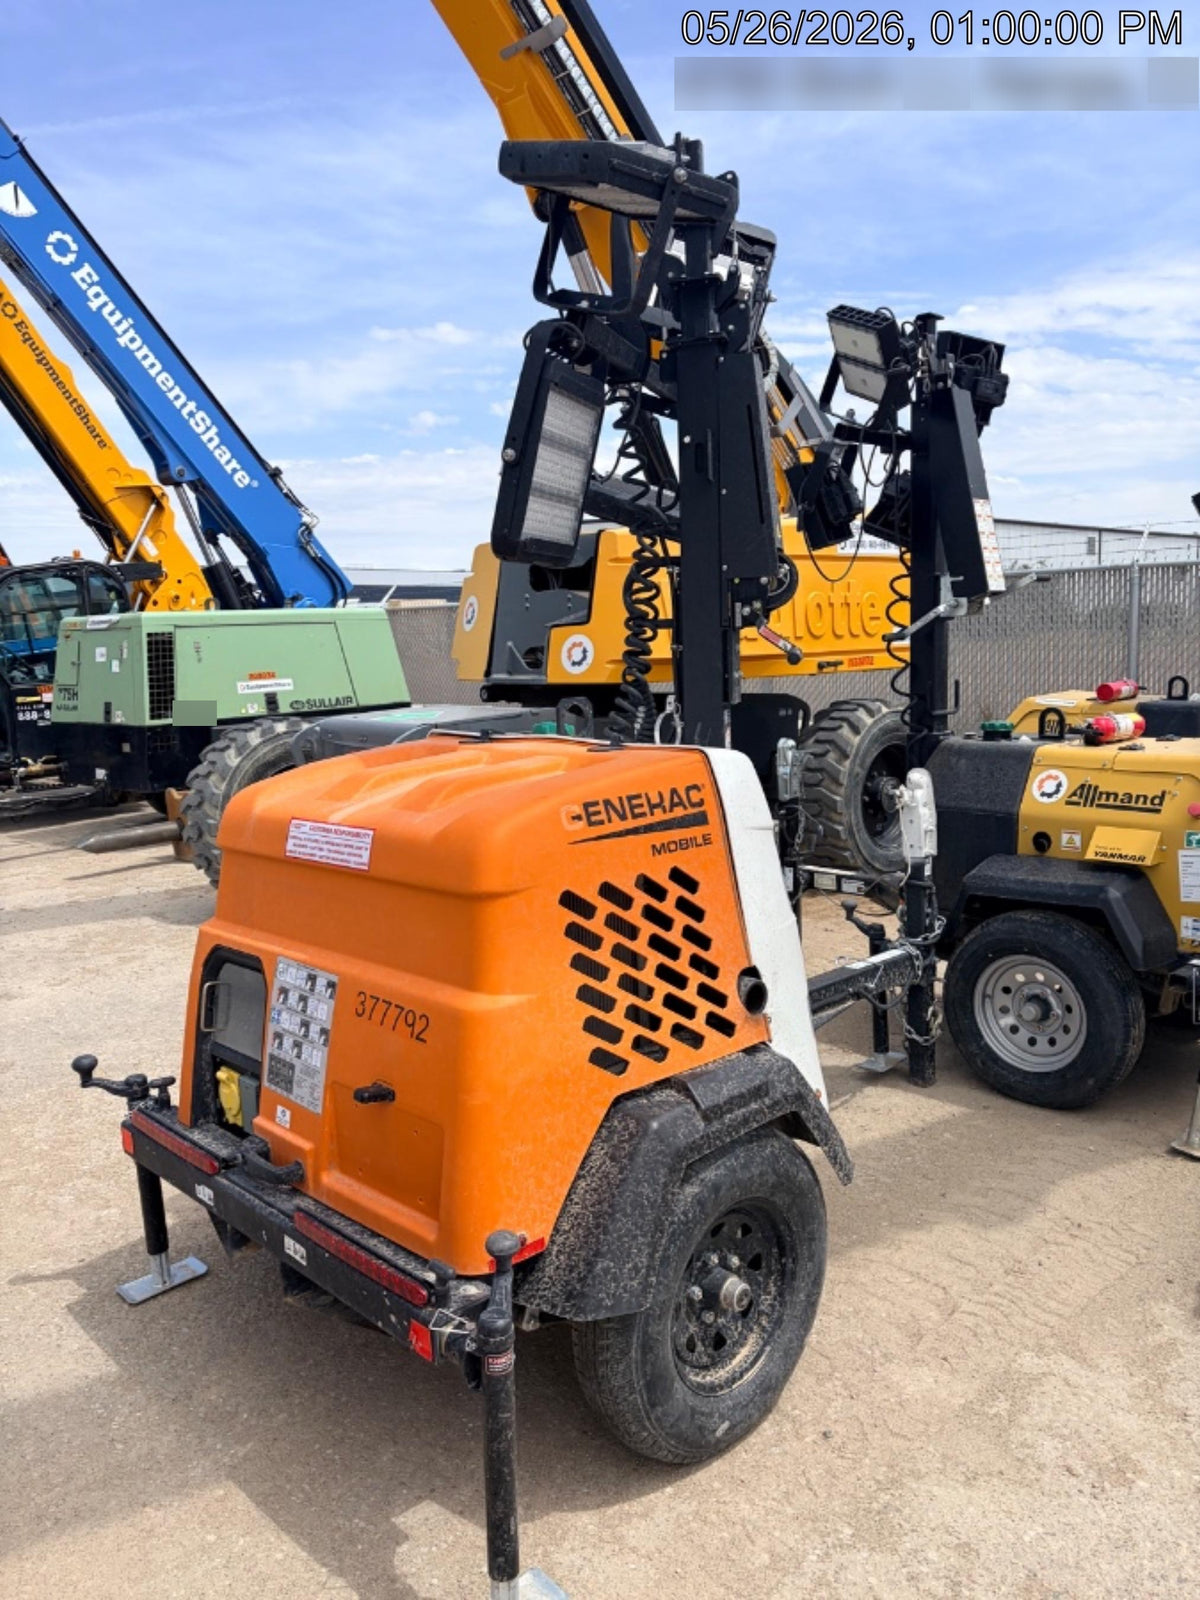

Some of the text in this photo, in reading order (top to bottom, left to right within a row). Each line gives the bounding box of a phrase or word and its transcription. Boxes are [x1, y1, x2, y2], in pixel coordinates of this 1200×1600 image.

[305, 695, 354, 710] SULLAIR
[1067, 783, 1167, 808] Allmand
[650, 833, 713, 858] MOBILE
[354, 990, 431, 1045] 377792
